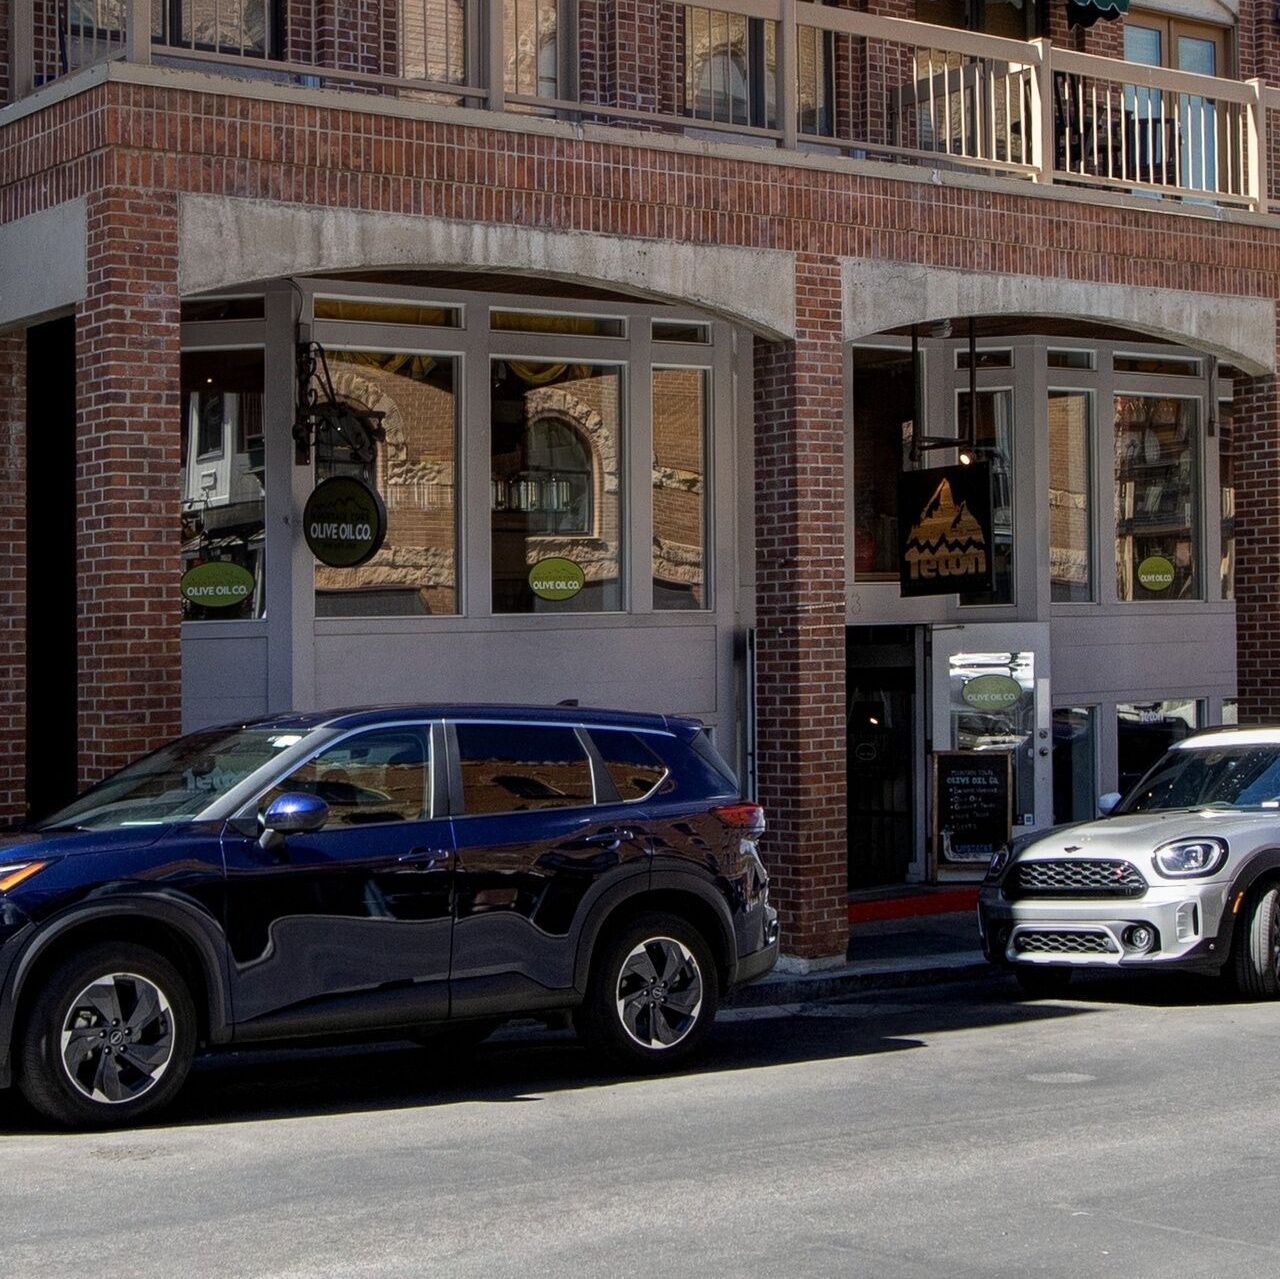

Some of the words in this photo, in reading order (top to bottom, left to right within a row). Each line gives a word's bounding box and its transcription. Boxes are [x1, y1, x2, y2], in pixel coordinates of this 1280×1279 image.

[310, 523, 338, 539] OLIVE
[339, 523, 355, 540] OIL
[355, 523, 372, 540] CO.
[904, 544, 987, 580] Teton
[533, 580, 554, 589] OLIVE
[555, 580, 567, 589] OIL
[186, 586, 214, 596] OLIVE
[215, 585, 231, 595] OIL
[232, 585, 249, 595] CO.
[967, 693, 990, 701] OLIVE
[990, 693, 1003, 701] OIL
